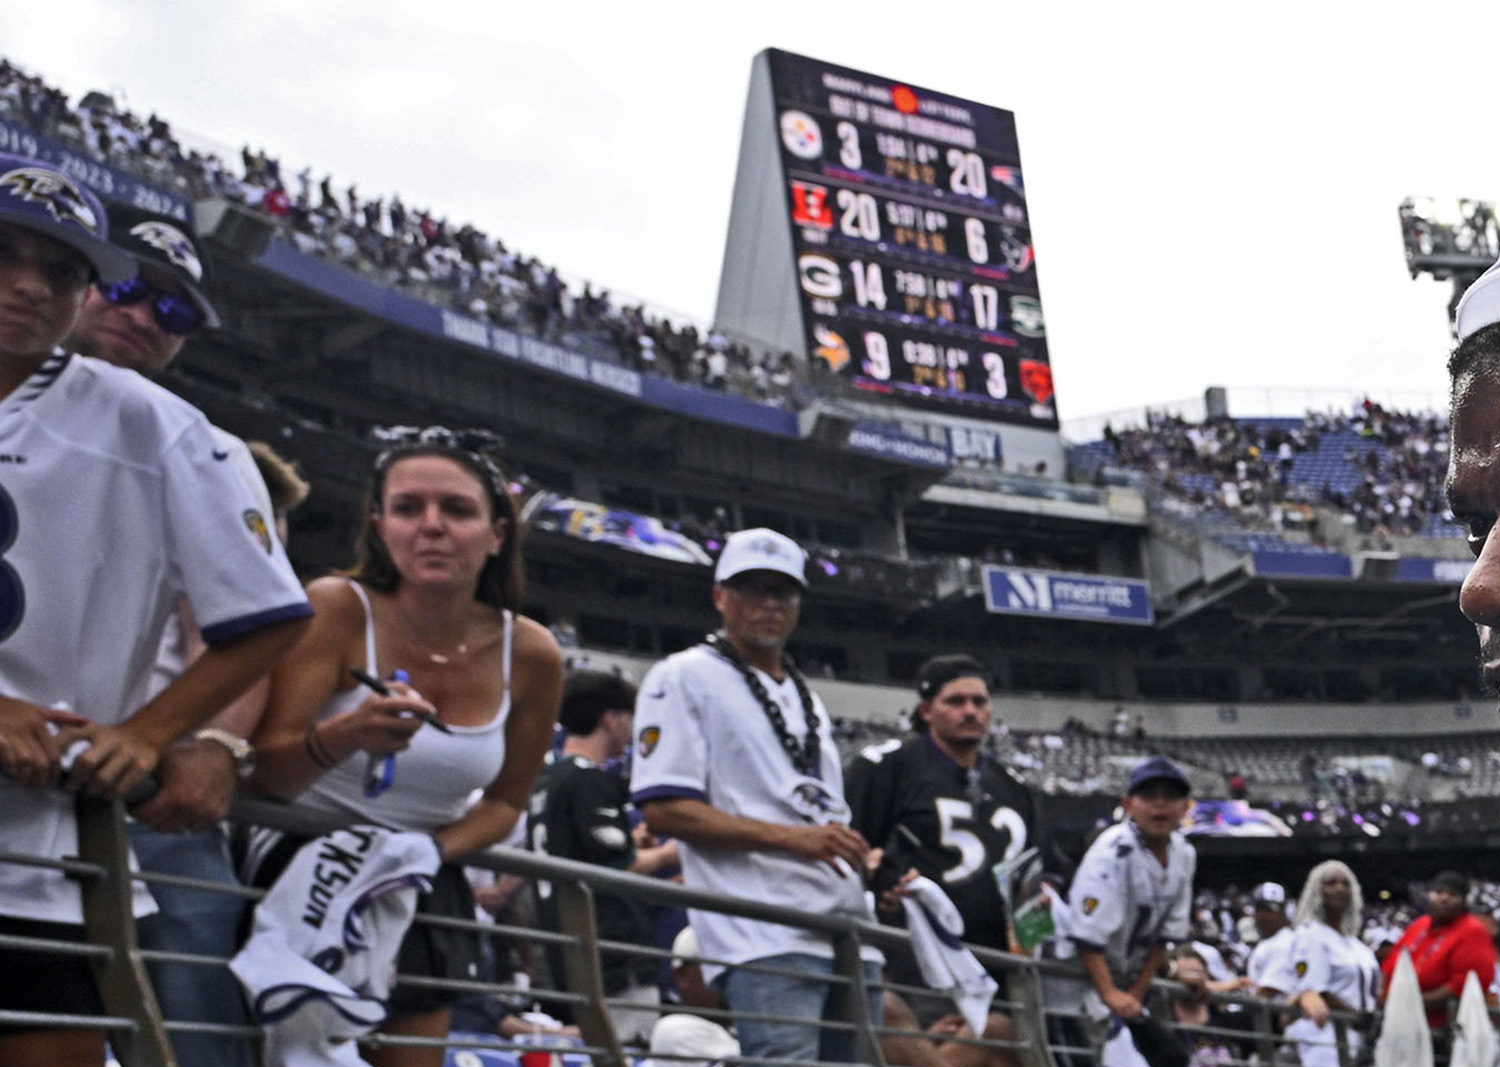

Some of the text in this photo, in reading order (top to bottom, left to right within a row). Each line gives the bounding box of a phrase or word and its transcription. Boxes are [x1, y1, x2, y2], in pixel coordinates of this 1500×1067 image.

[837, 121, 862, 170] 3
[946, 148, 988, 199] 20
[836, 189, 881, 242] 20
[964, 217, 991, 264] 6
[849, 259, 888, 311] 14
[969, 283, 999, 331] 17
[864, 331, 892, 381] 9
[982, 352, 1008, 400] 3
[935, 797, 1027, 882] 52
